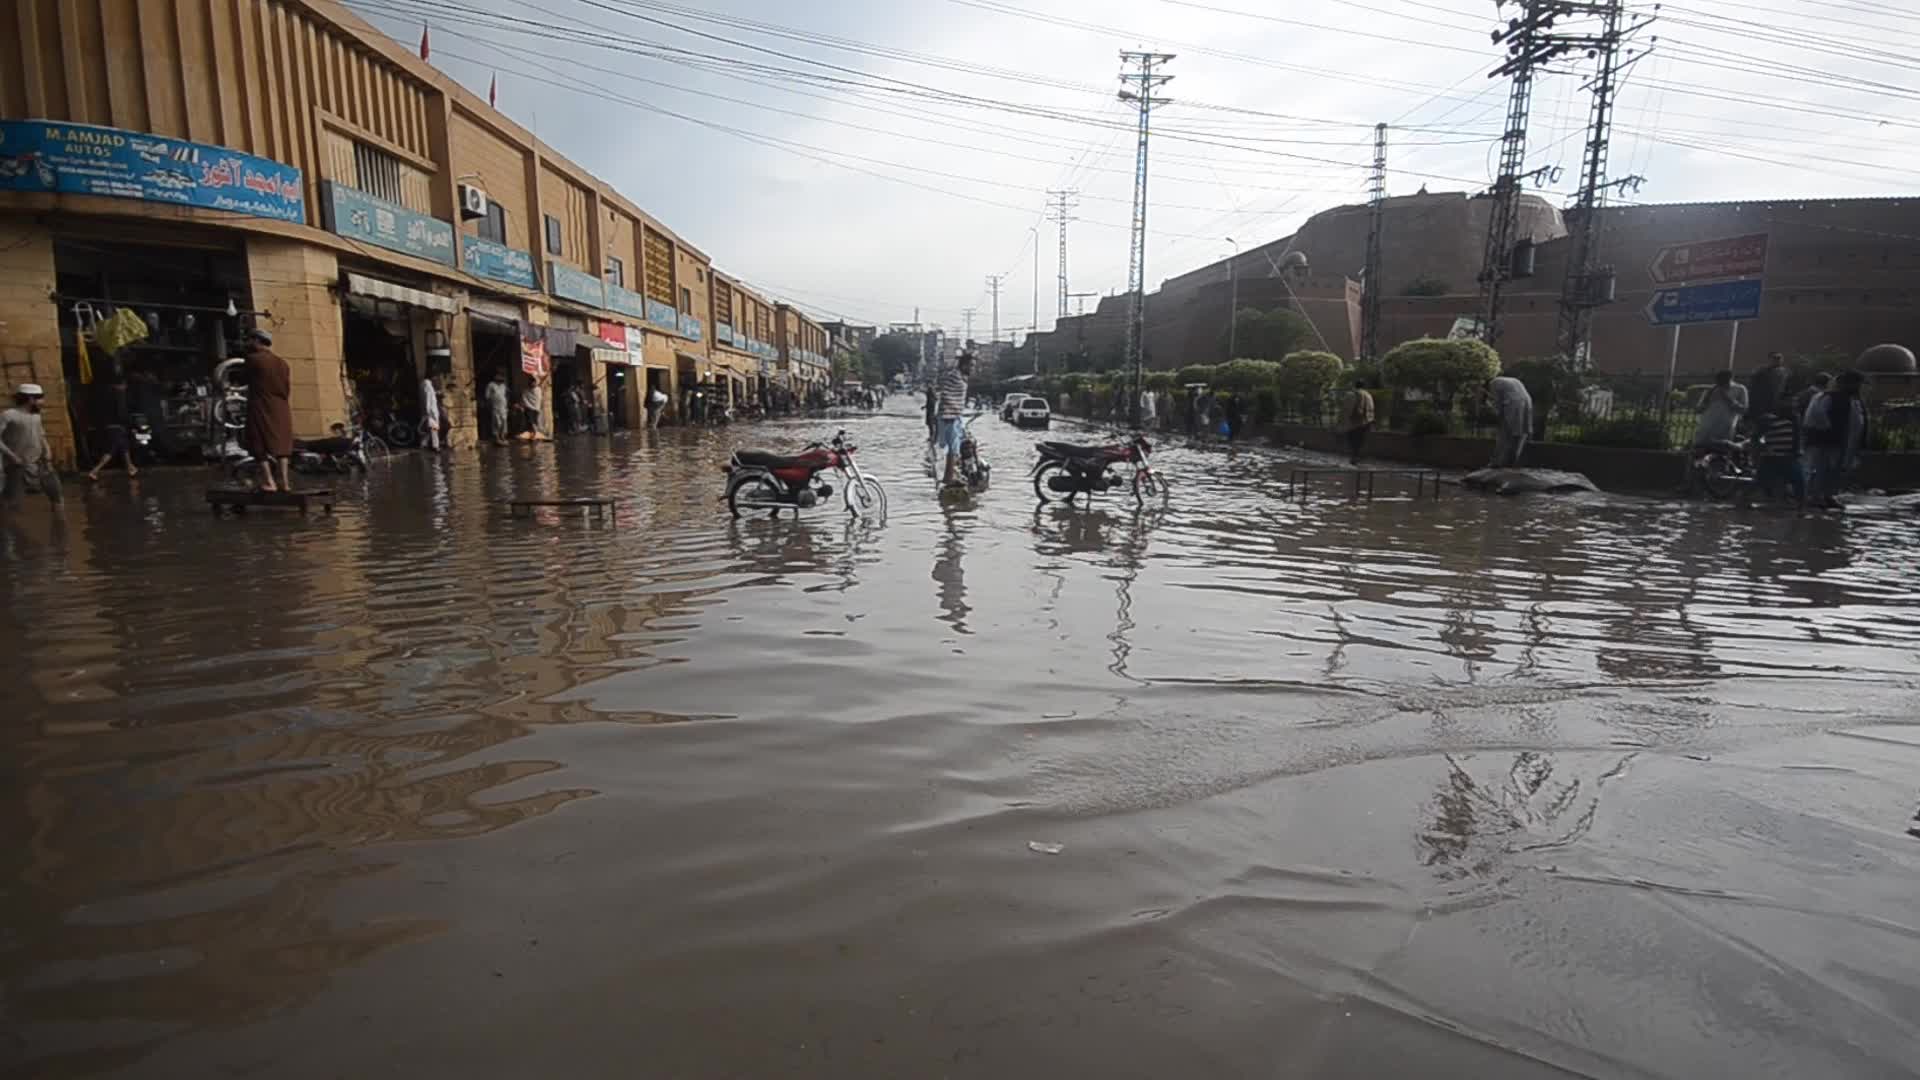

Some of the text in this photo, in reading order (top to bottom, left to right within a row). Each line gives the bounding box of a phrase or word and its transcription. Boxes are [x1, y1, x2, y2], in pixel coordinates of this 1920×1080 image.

[46, 127, 125, 147] M.AMJAD
[65, 143, 112, 157] AUTOS
[198, 157, 242, 188] آٹوز
[243, 168, 281, 196] امجد
